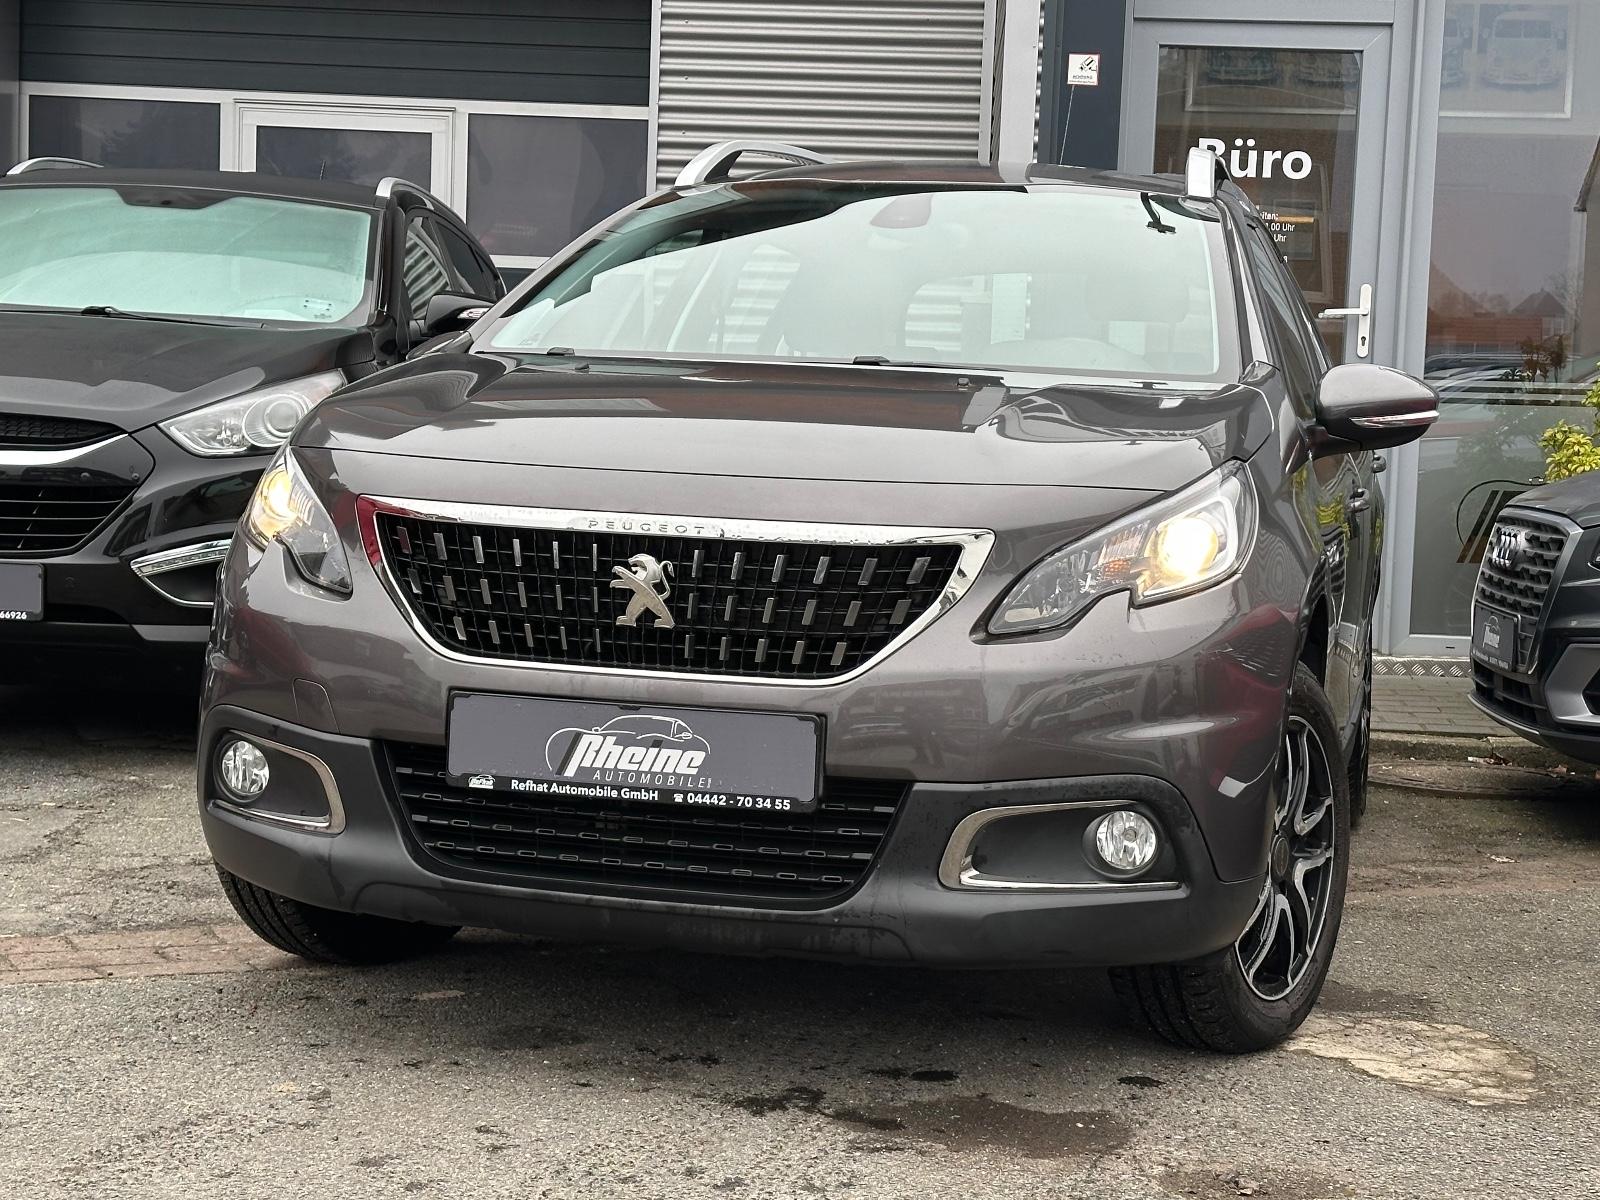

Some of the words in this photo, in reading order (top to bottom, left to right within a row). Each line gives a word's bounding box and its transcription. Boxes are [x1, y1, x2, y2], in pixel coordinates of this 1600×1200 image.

[1282, 223, 1295, 232] Uhr
[1273, 234, 1287, 242] Uhr
[588, 519, 705, 535] PEUGEOT
[592, 769, 707, 789] AUTOMOBILE
[511, 779, 549, 793] Refhat
[550, 782, 618, 798] Automobile
[620, 788, 659, 801] GmbH
[687, 792, 727, 806] 04442
[737, 796, 753, 808] 70
[755, 797, 772, 809] 34
[774, 799, 791, 810] 55
